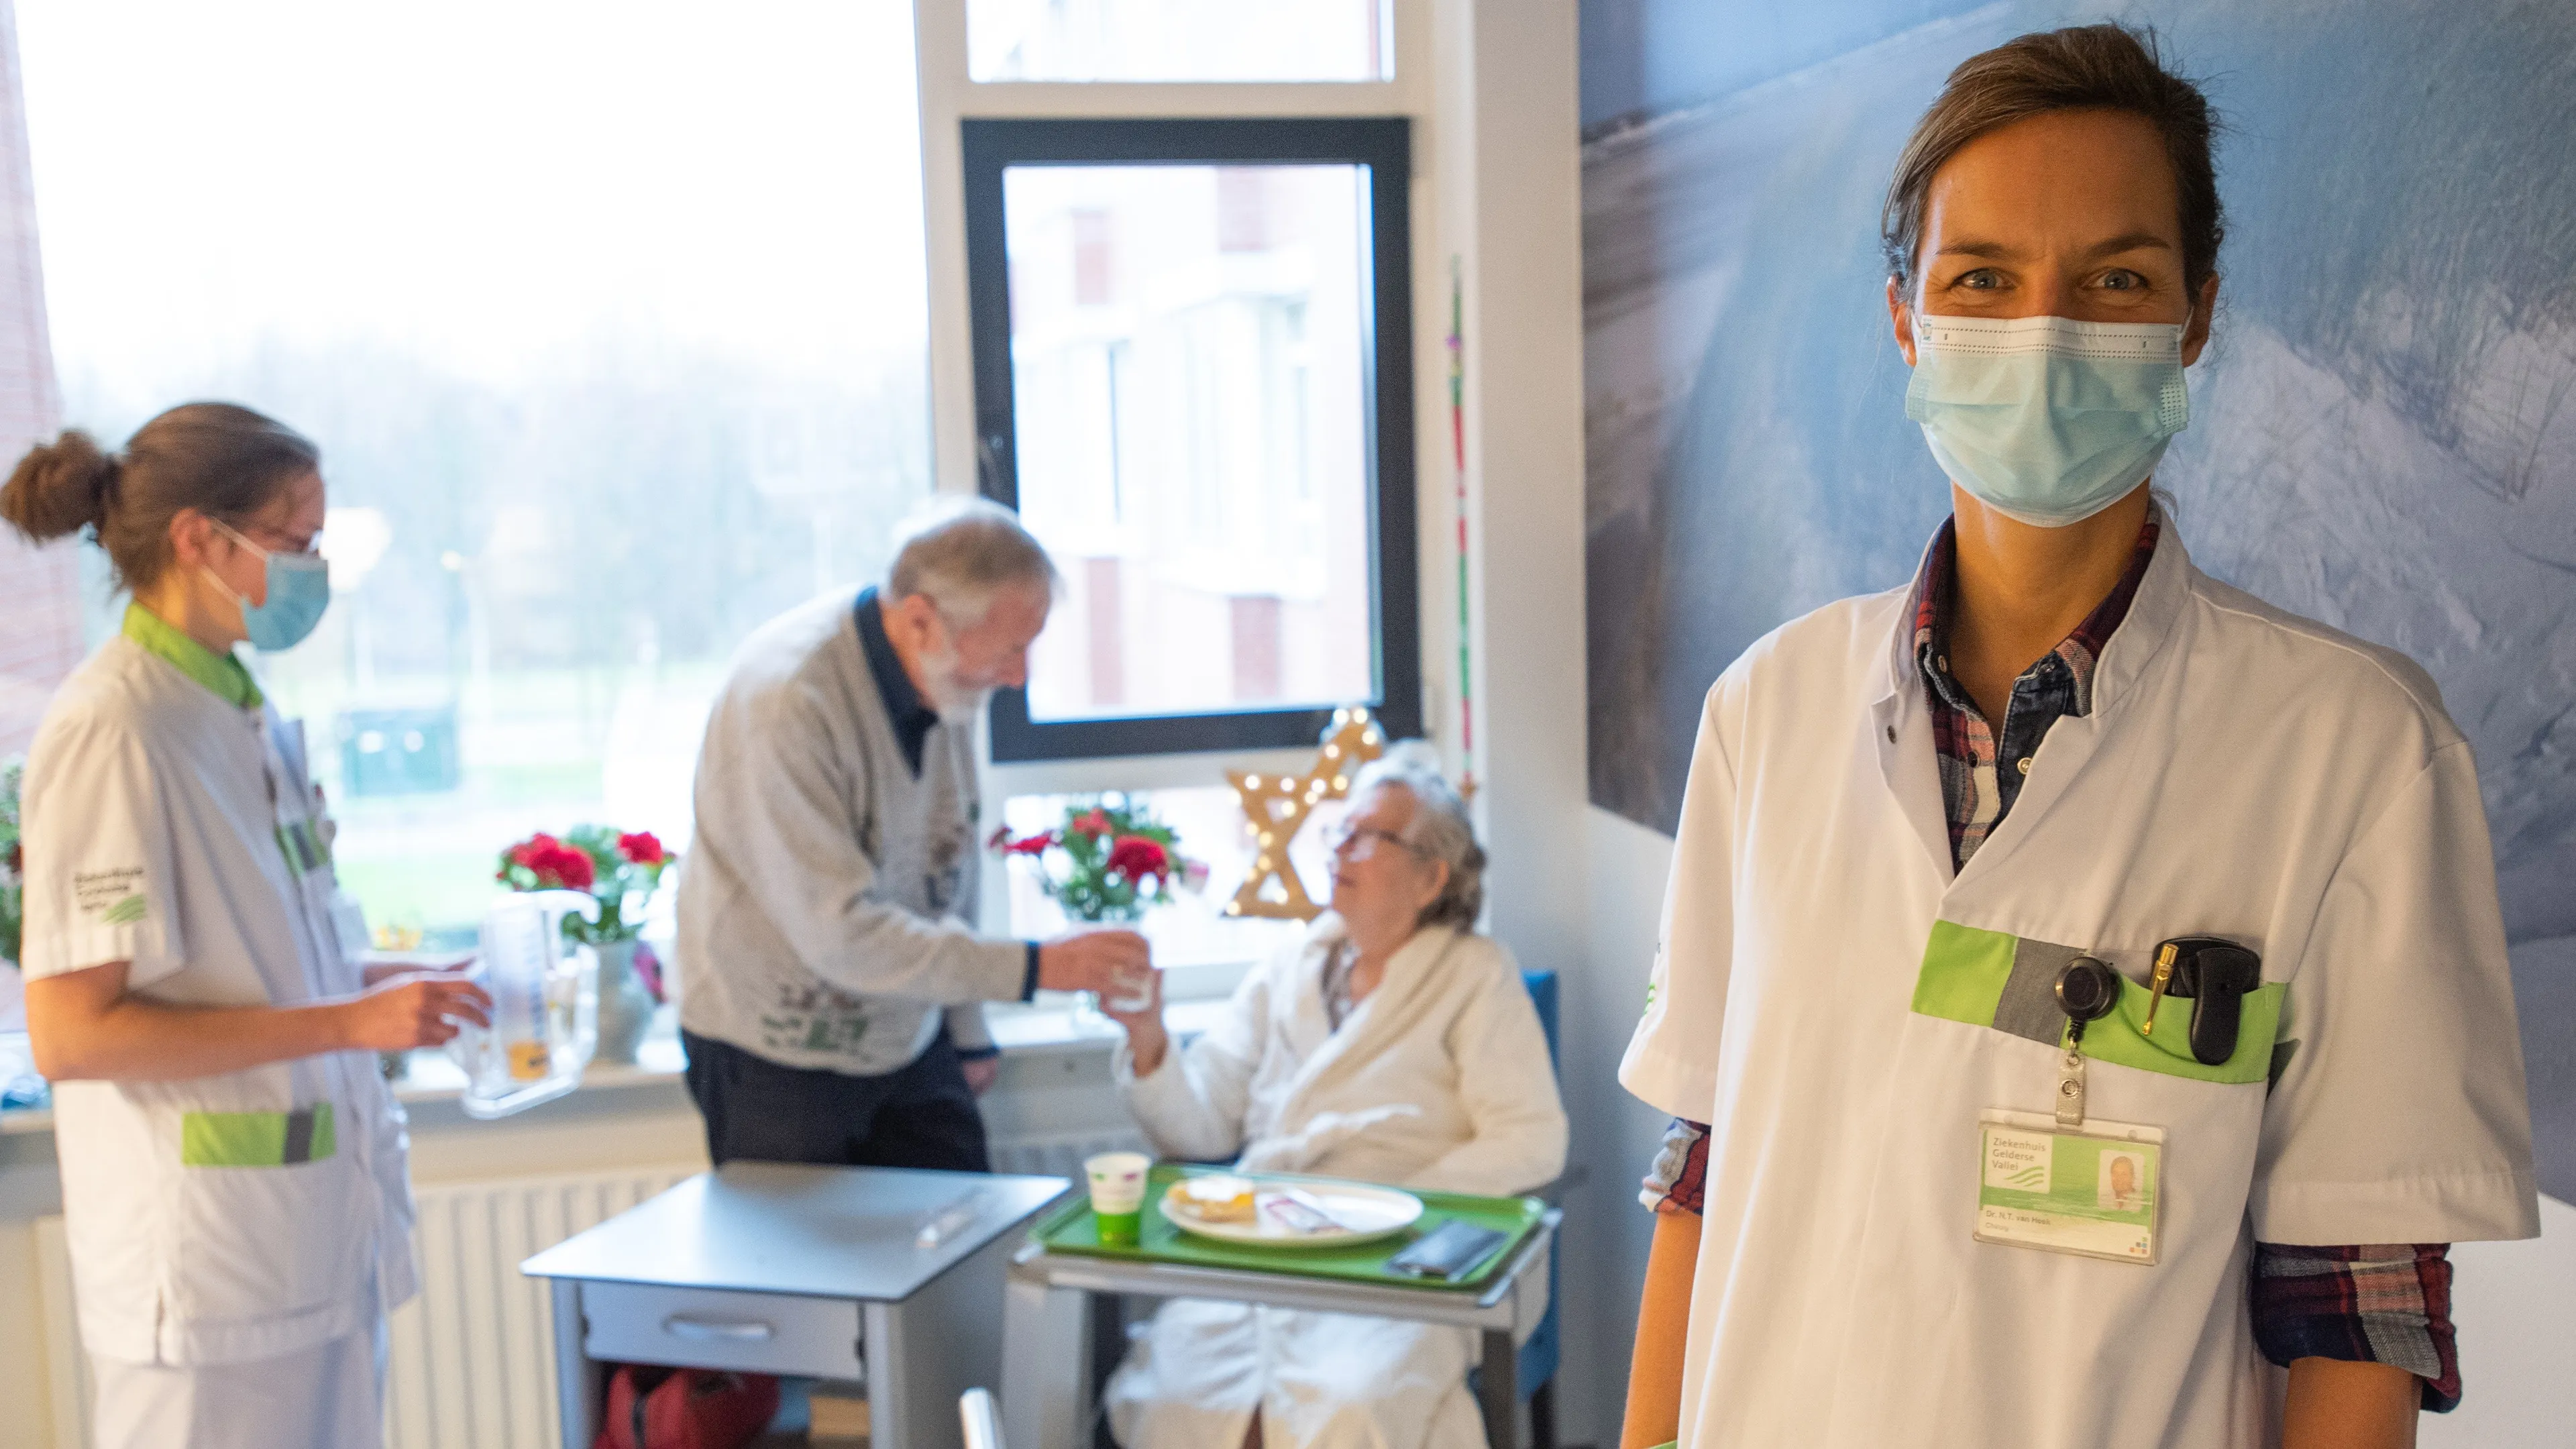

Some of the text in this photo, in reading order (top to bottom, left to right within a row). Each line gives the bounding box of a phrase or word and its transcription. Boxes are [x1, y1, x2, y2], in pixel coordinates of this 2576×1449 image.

[1993, 1137, 2046, 1152] Ziekenhuis
[1992, 1148, 2035, 1162] Gelderse
[1992, 1160, 2019, 1171] Vallei
[1986, 1210, 1997, 1218] Dr.
